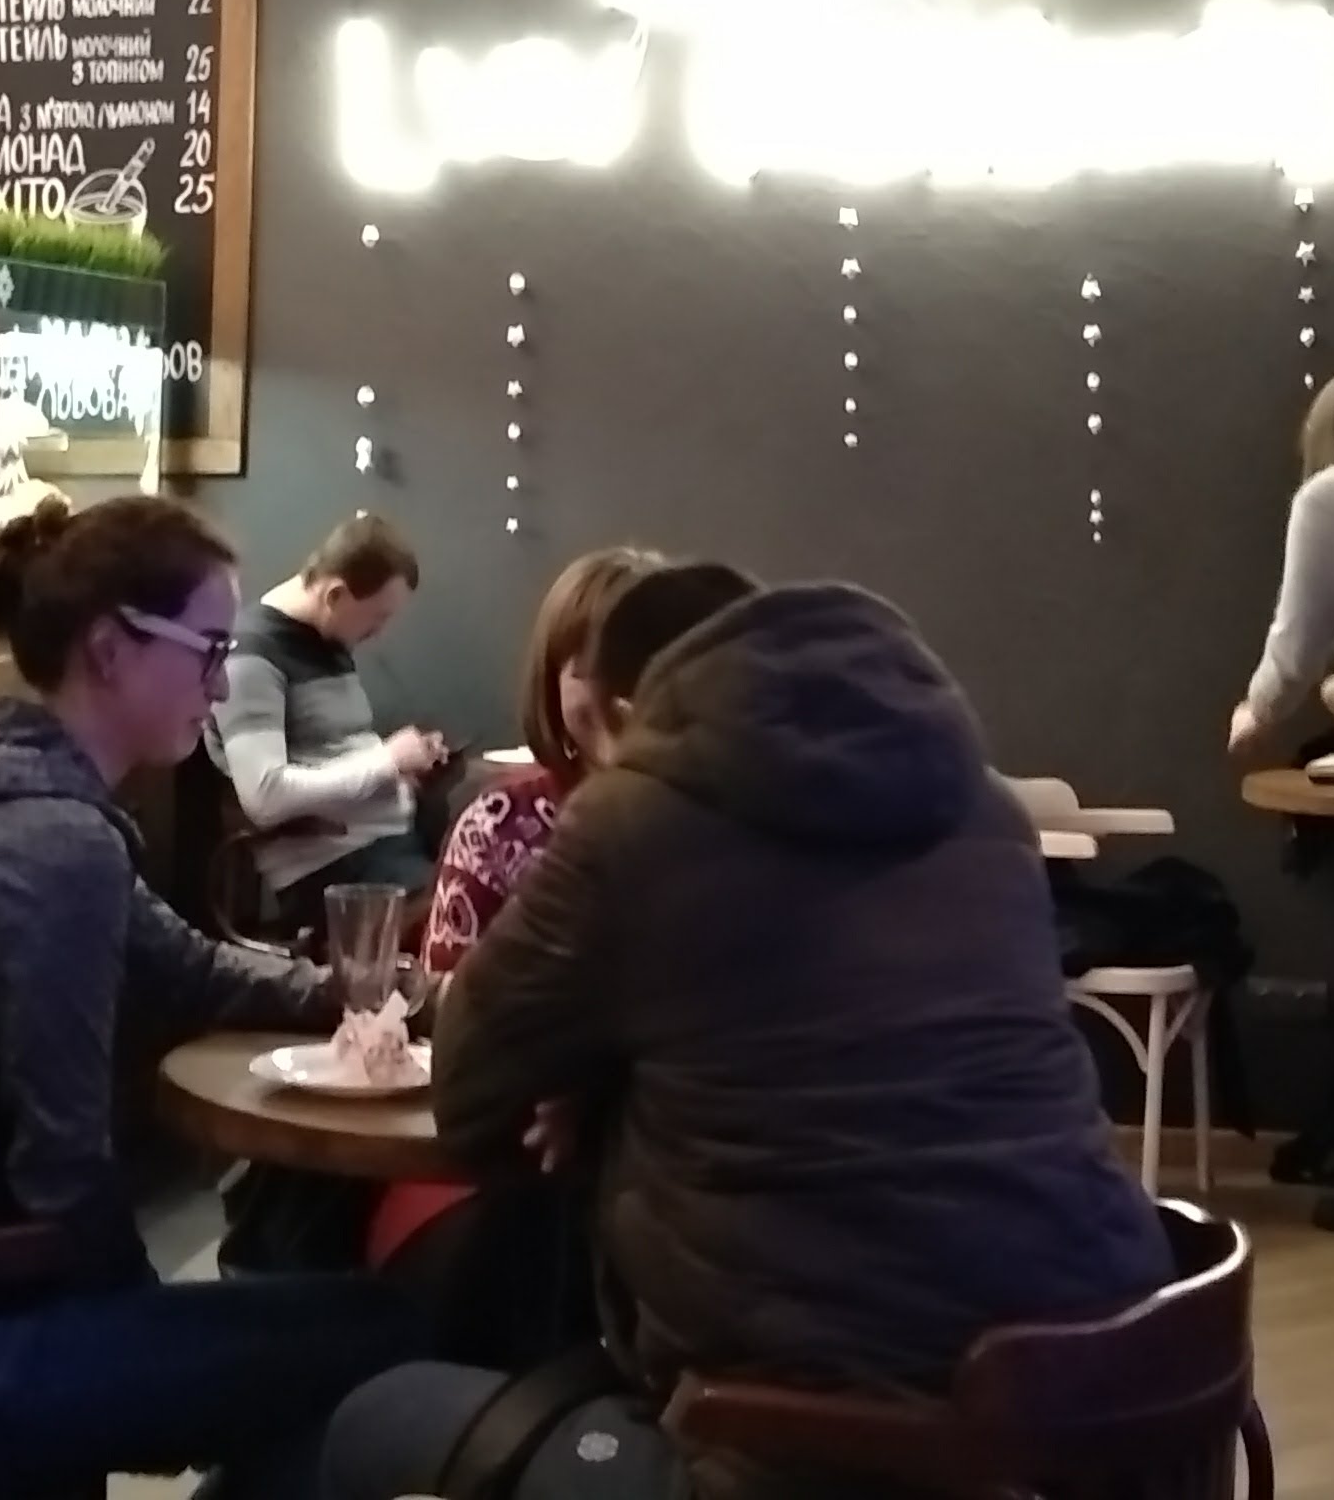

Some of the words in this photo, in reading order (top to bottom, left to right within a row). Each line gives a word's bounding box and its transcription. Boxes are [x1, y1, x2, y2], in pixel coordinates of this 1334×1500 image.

[186, 89, 211, 124] 14
[179, 128, 212, 168] 20
[174, 173, 216, 214] 25
